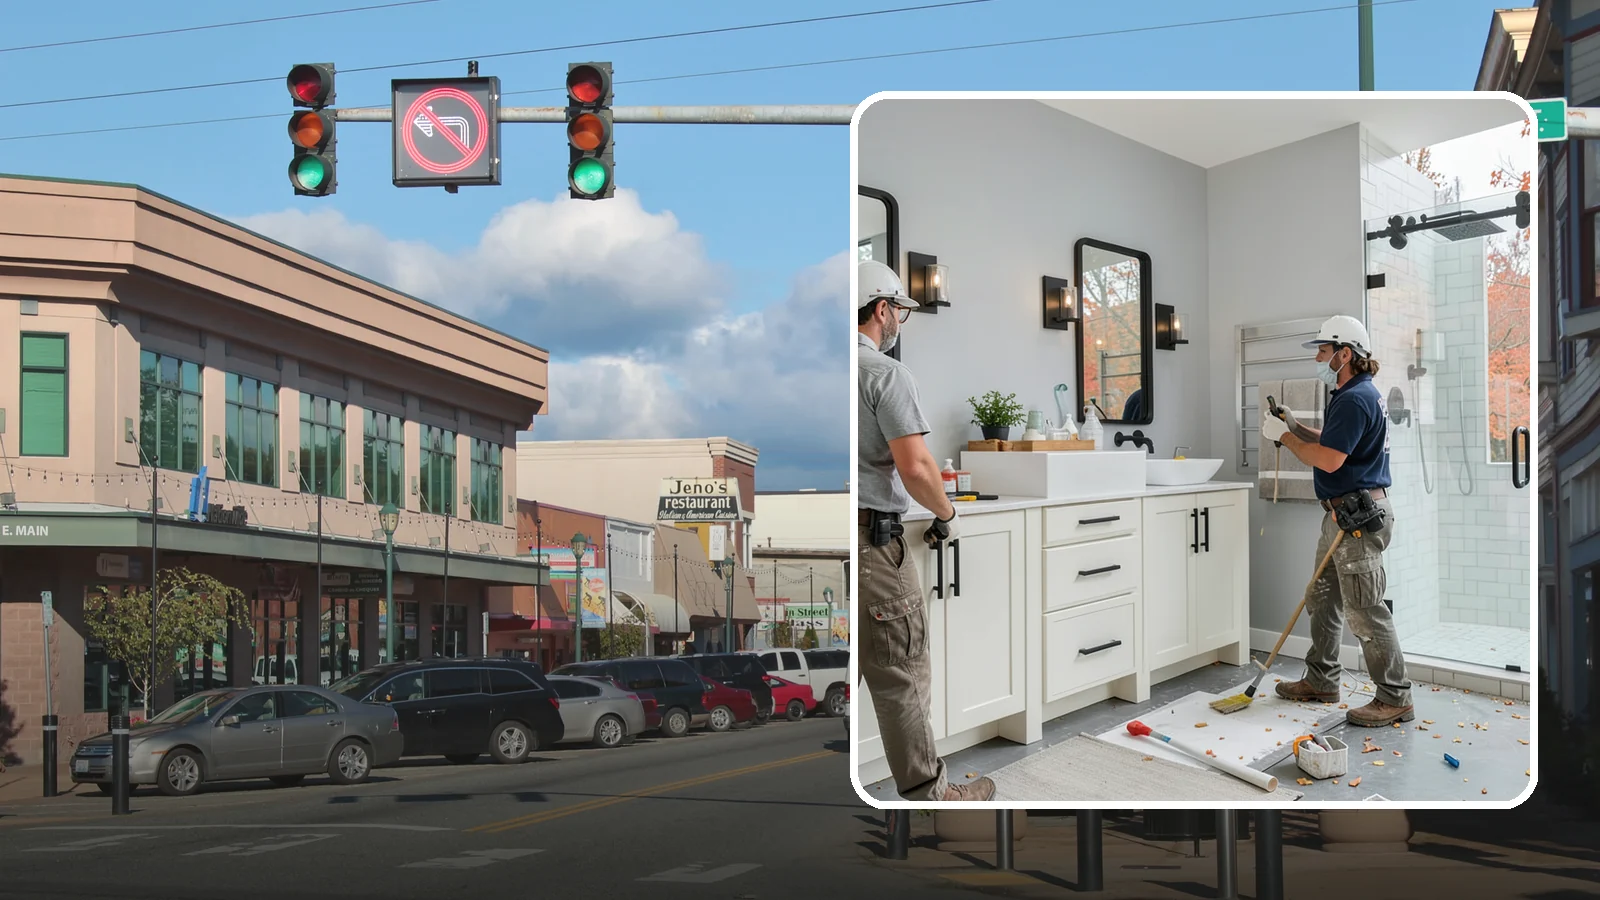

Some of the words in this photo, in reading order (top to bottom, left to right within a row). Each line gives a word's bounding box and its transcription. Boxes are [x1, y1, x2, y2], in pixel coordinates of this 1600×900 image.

[669, 480, 727, 494] Jeno's
[665, 496, 731, 509] restaurant
[686, 510, 715, 519] American
[715, 510, 738, 519] Cuisine
[2, 525, 13, 536] E.
[16, 525, 49, 536] MAIN
[797, 607, 828, 617] Street
